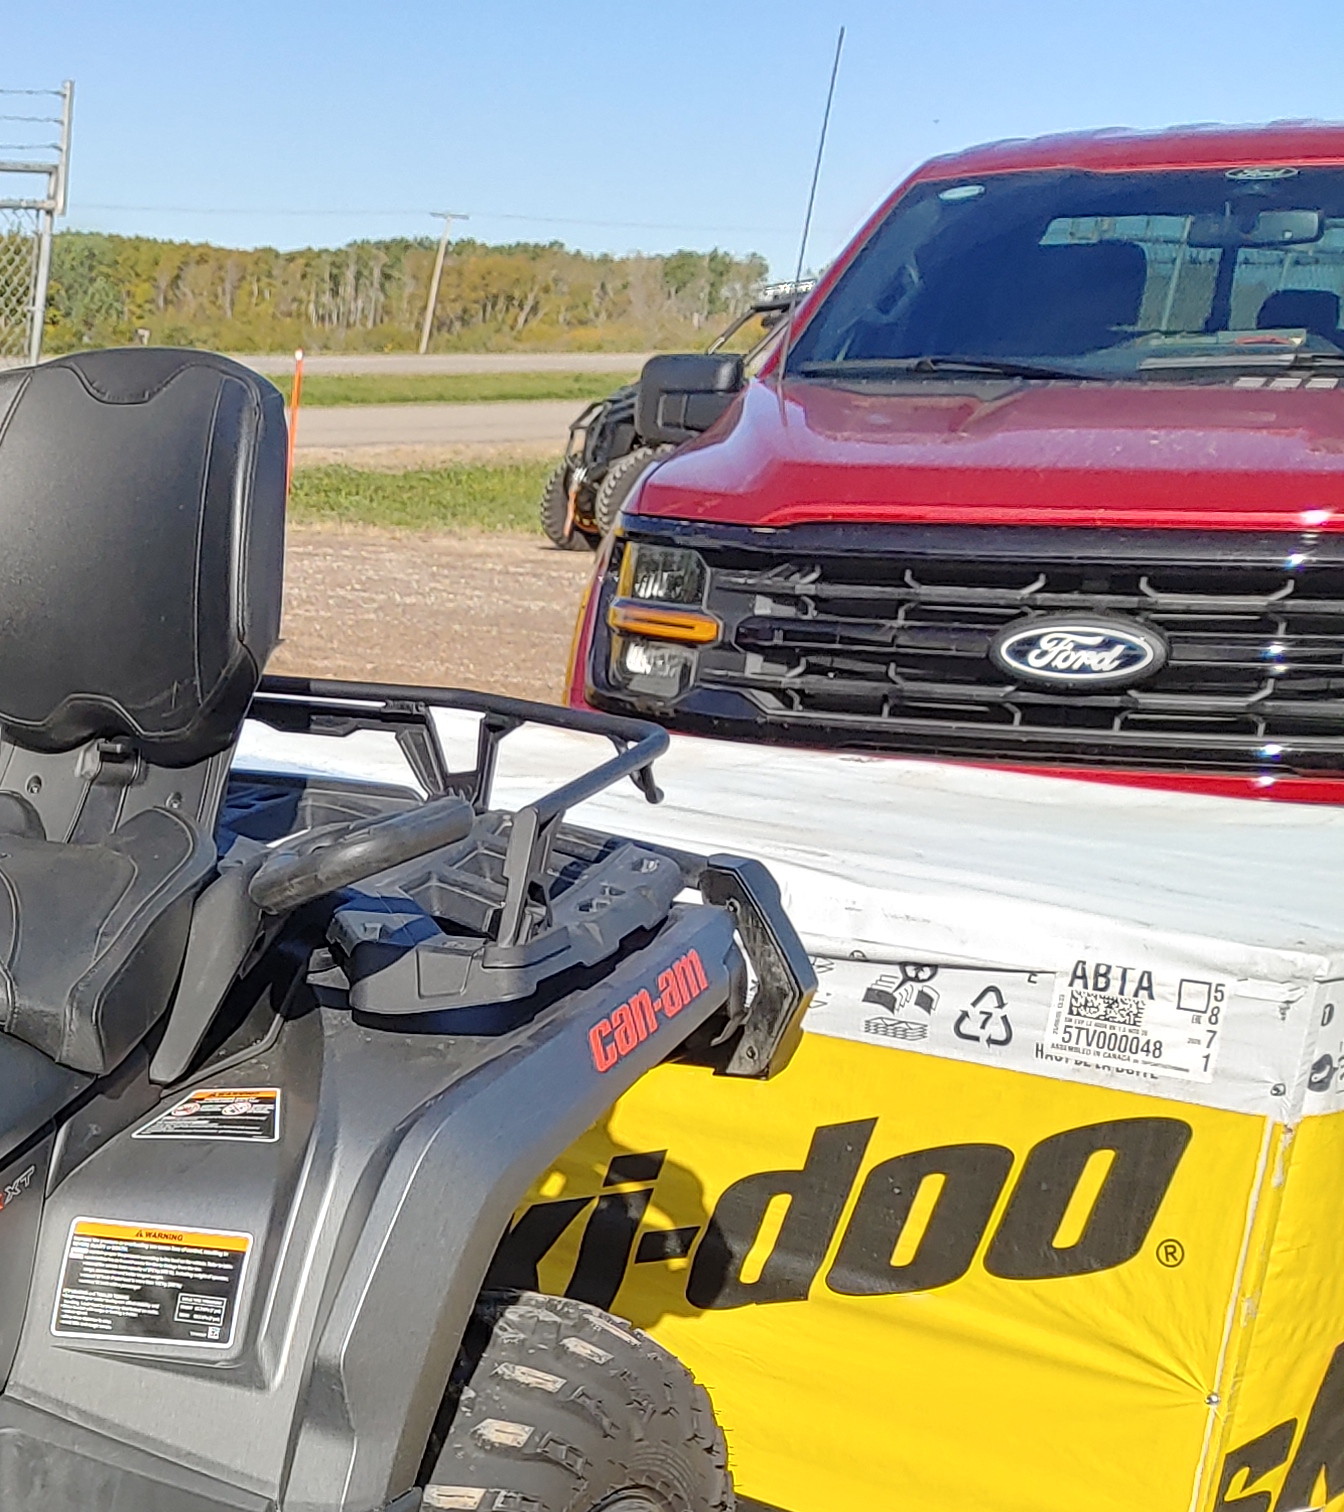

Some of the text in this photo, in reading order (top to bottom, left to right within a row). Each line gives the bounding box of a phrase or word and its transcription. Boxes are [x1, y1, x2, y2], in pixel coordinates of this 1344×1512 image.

[1028, 632, 1126, 671] Ford
[1068, 959, 1155, 1001] ABTA
[1213, 983, 1226, 1003] 5
[588, 948, 709, 1073] can-am
[1208, 1006, 1221, 1026] 8
[1062, 1024, 1163, 1060] 5TV000048
[1205, 1029, 1218, 1049] 7
[1201, 1053, 1211, 1072] 1
[4, 1164, 36, 1206] XT
[144, 1230, 184, 1242] WARNING
